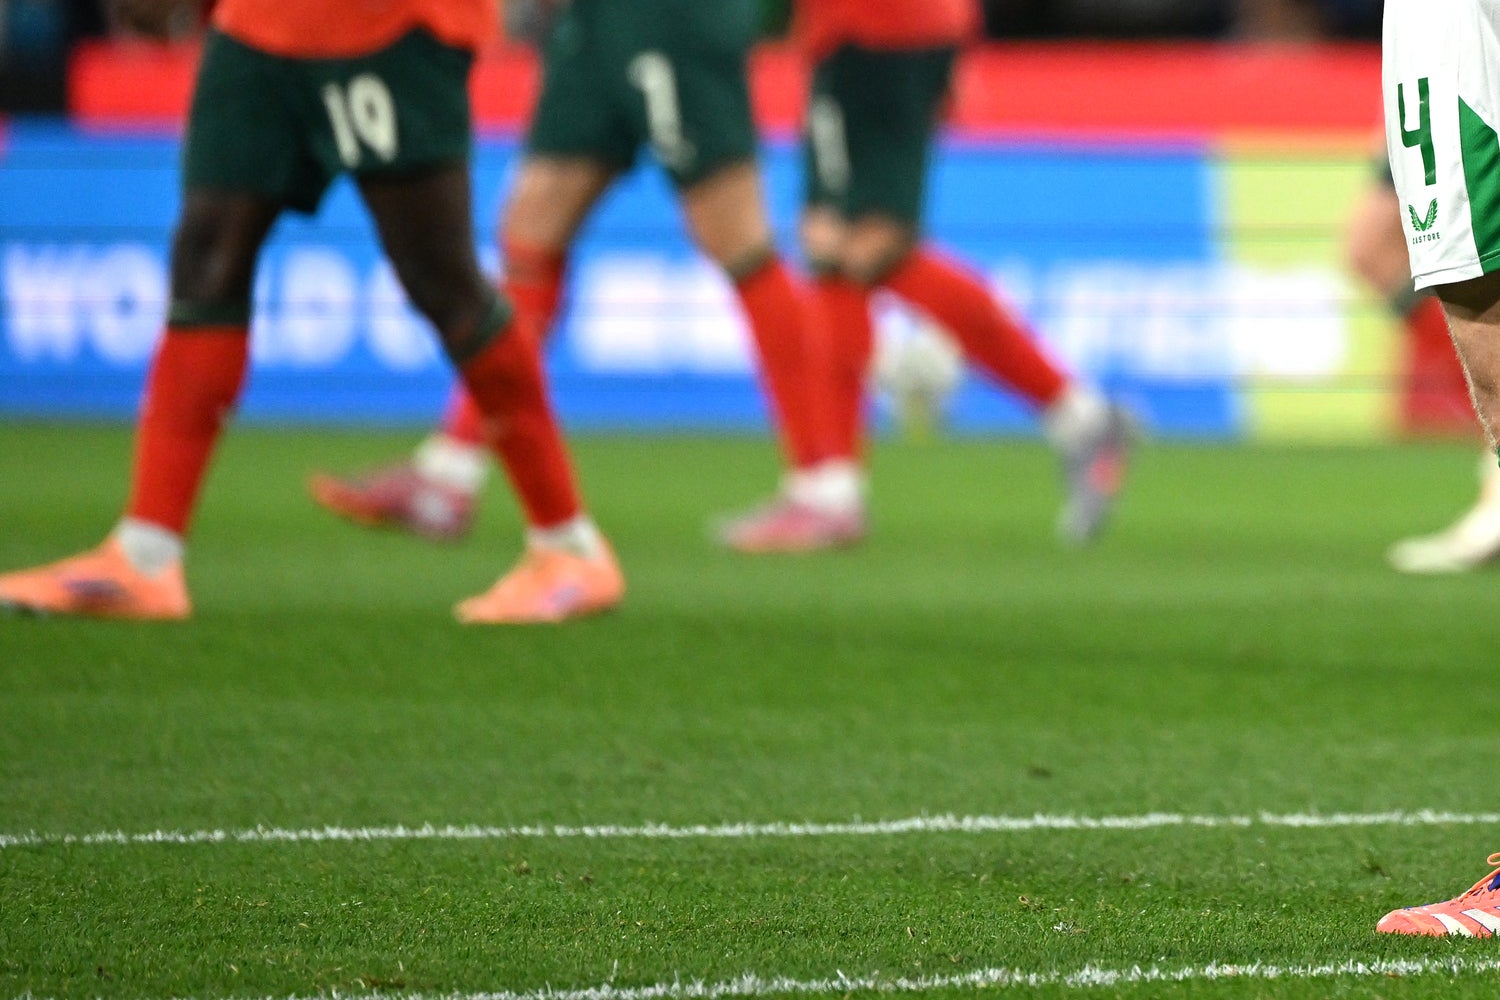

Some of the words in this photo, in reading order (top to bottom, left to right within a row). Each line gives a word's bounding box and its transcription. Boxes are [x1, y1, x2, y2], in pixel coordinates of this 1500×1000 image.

[321, 74, 399, 167] 19
[1398, 77, 1436, 186] 4
[3, 243, 362, 369] WOLD
